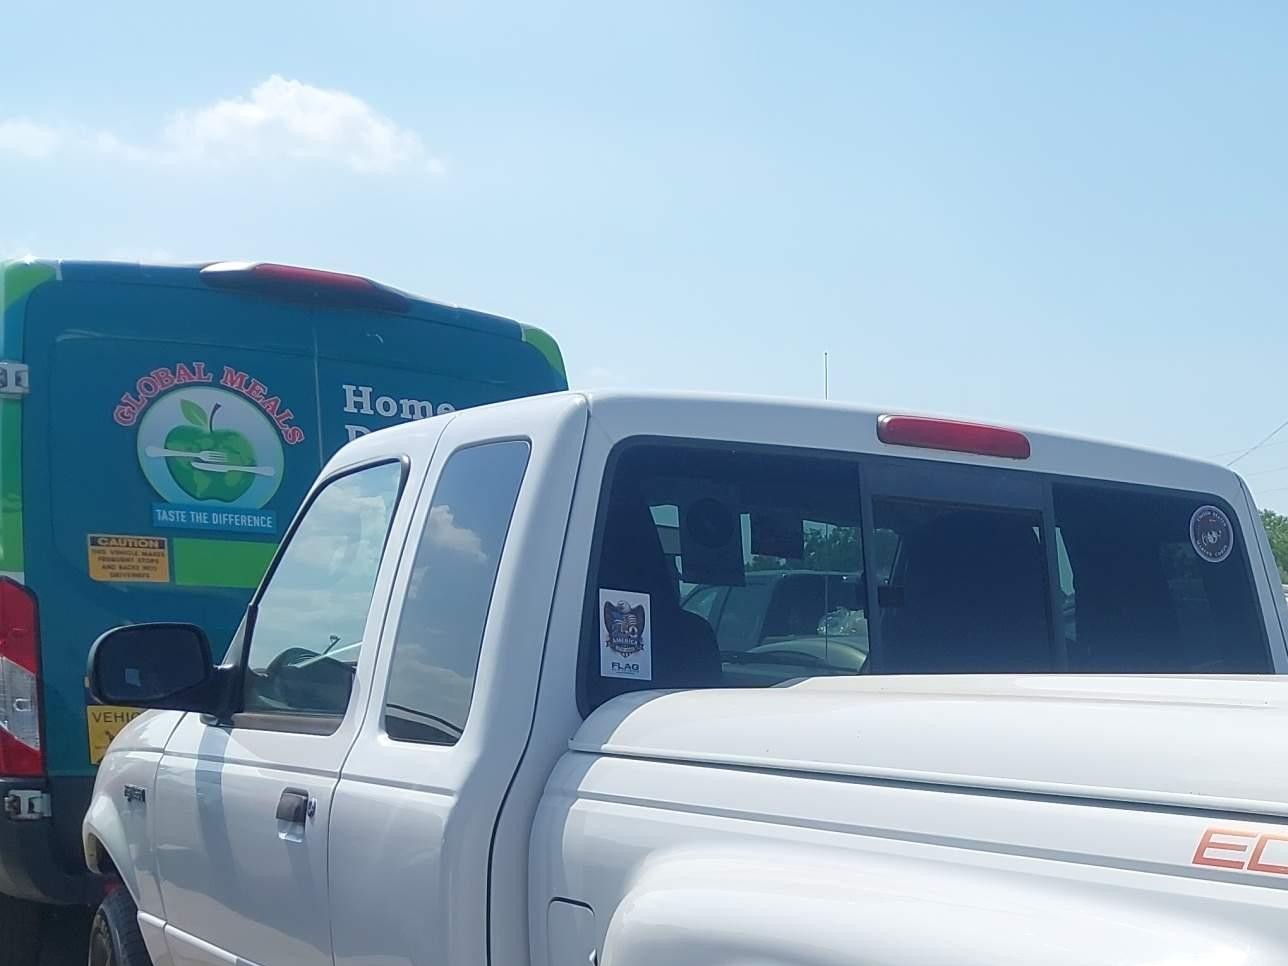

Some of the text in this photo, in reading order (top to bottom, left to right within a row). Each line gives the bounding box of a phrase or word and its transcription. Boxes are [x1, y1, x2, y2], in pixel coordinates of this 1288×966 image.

[113, 362, 304, 445] GLOBAL MEALS
[156, 509, 273, 528] TASTE THE DIFFERENCE
[97, 537, 159, 548] CAUTION
[611, 661, 640, 671] FLAG
